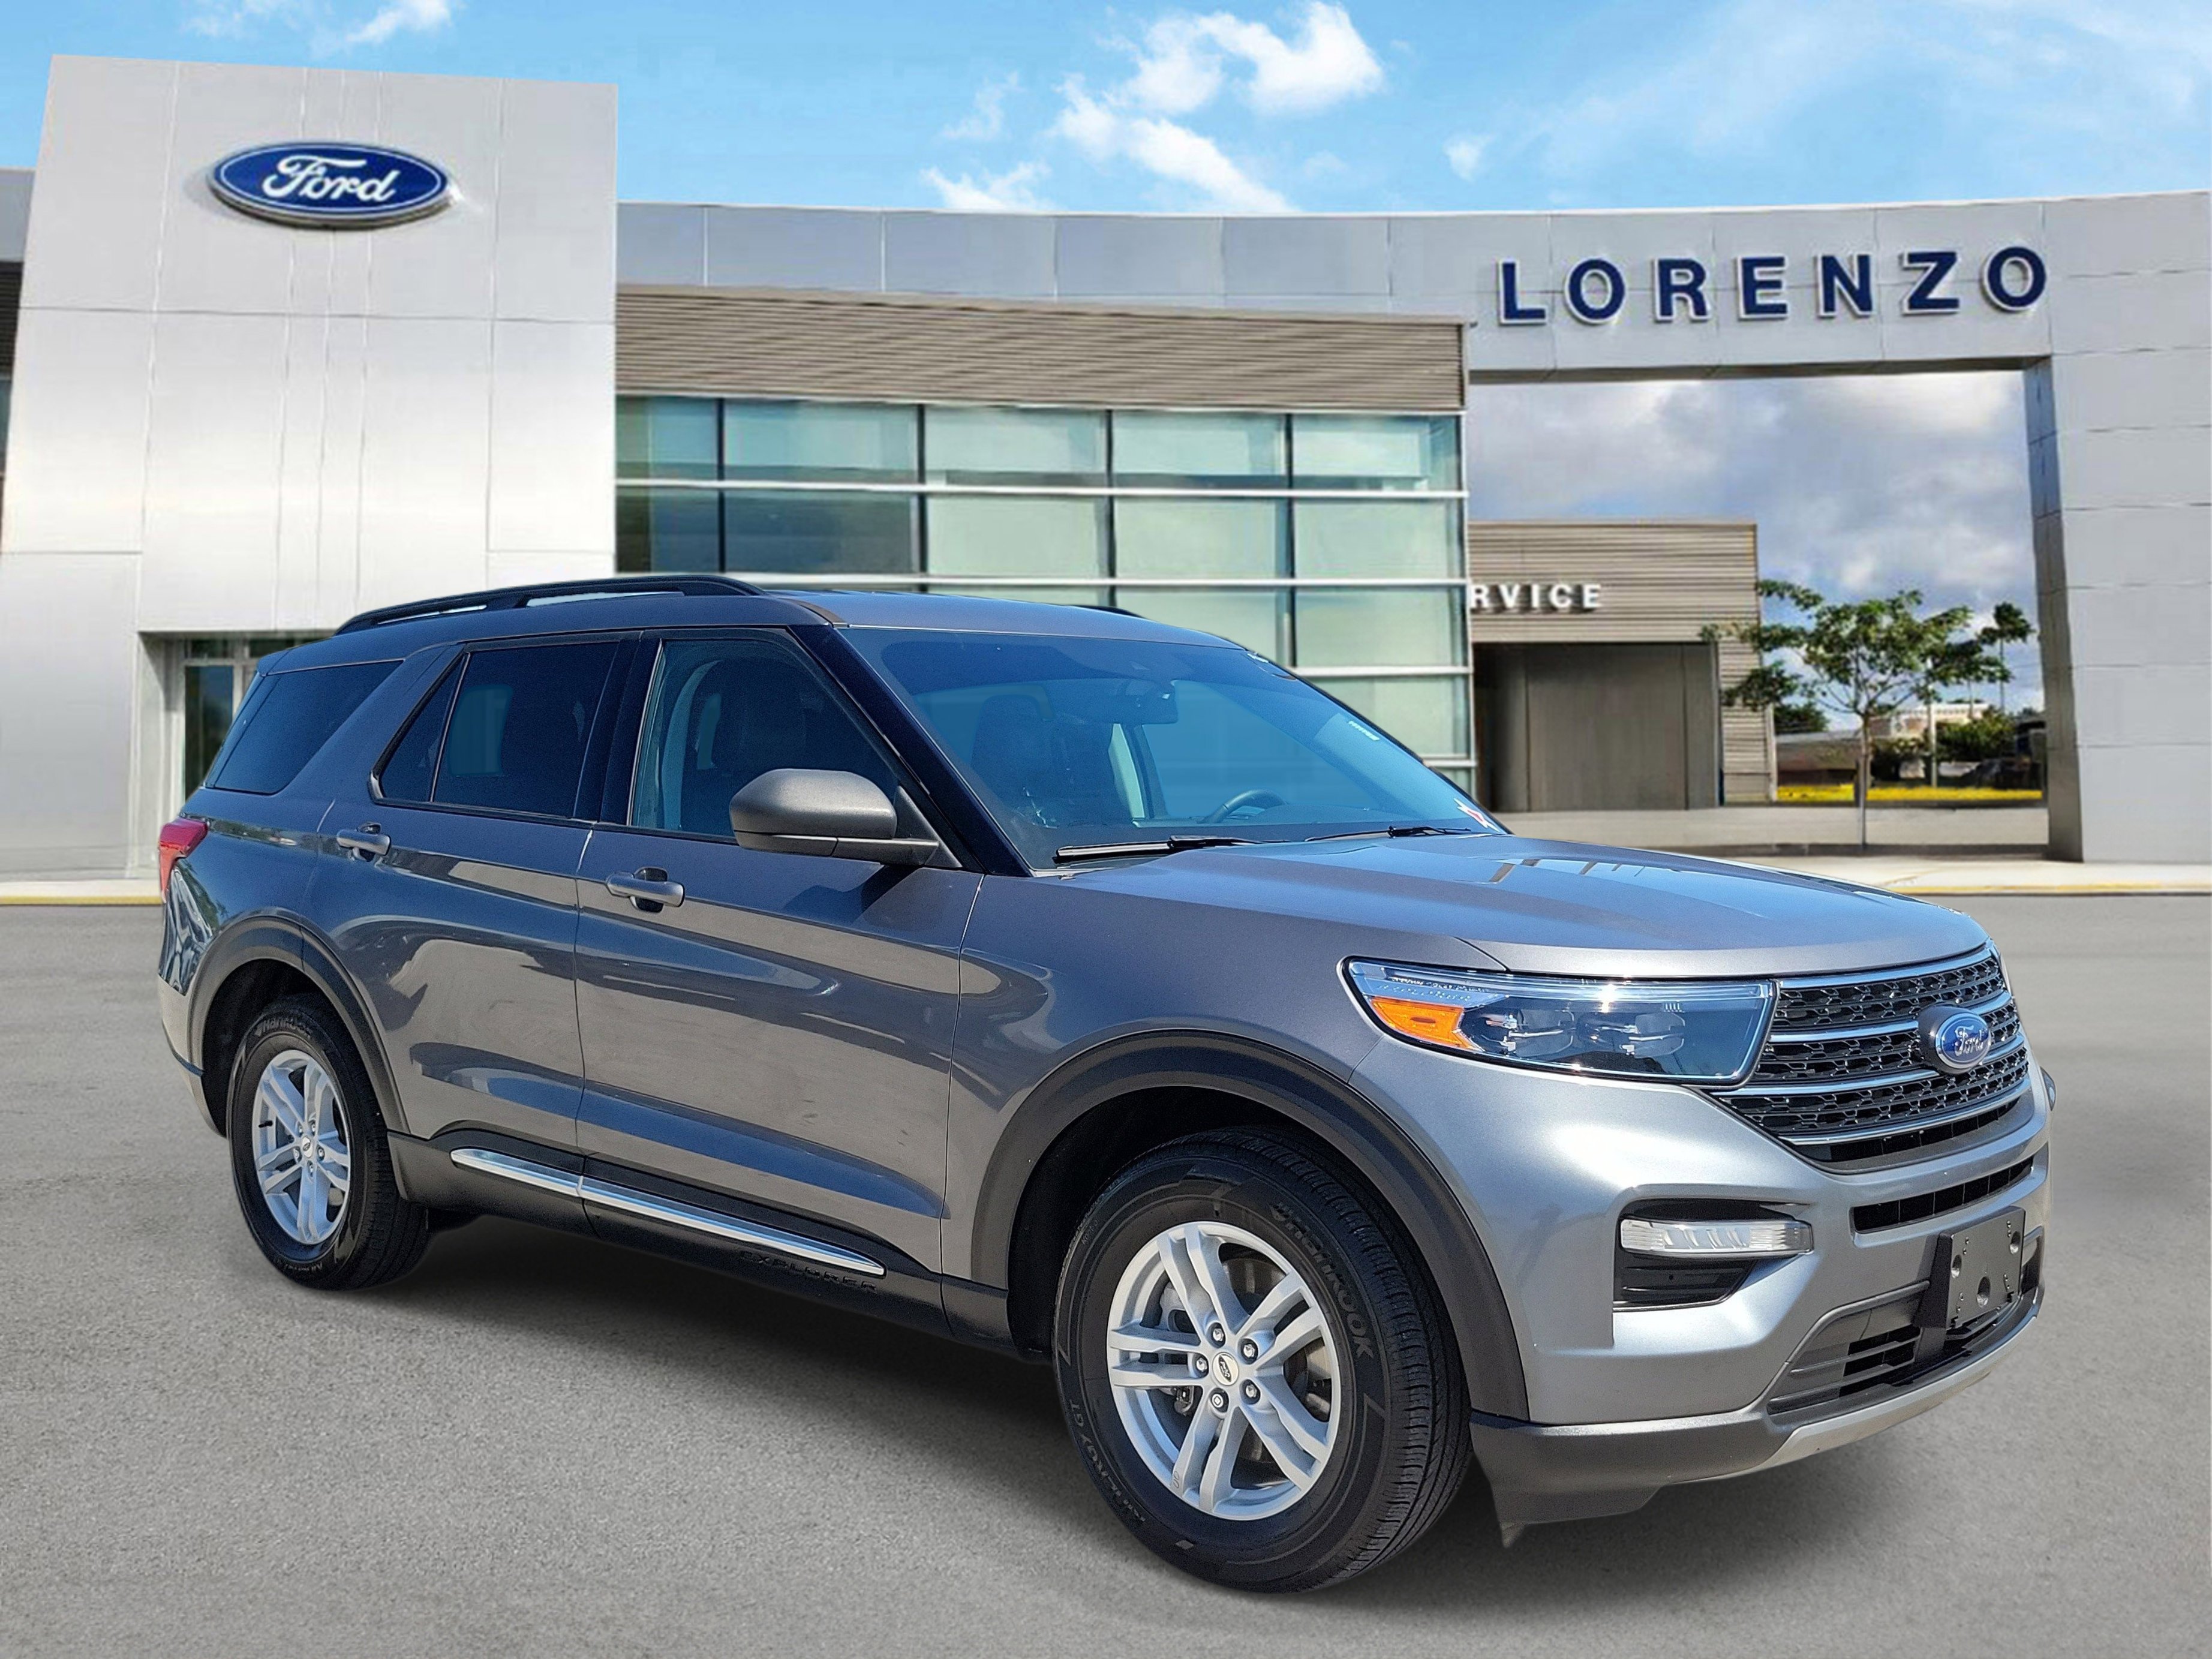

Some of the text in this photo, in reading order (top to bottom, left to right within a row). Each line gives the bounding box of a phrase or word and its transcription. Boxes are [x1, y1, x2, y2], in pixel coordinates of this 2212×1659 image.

[263, 154, 400, 202] Ford
[1498, 245, 2048, 324] LORENZO
[1469, 582, 1602, 608] RVICE
[1953, 1025, 1984, 1056] Ford
